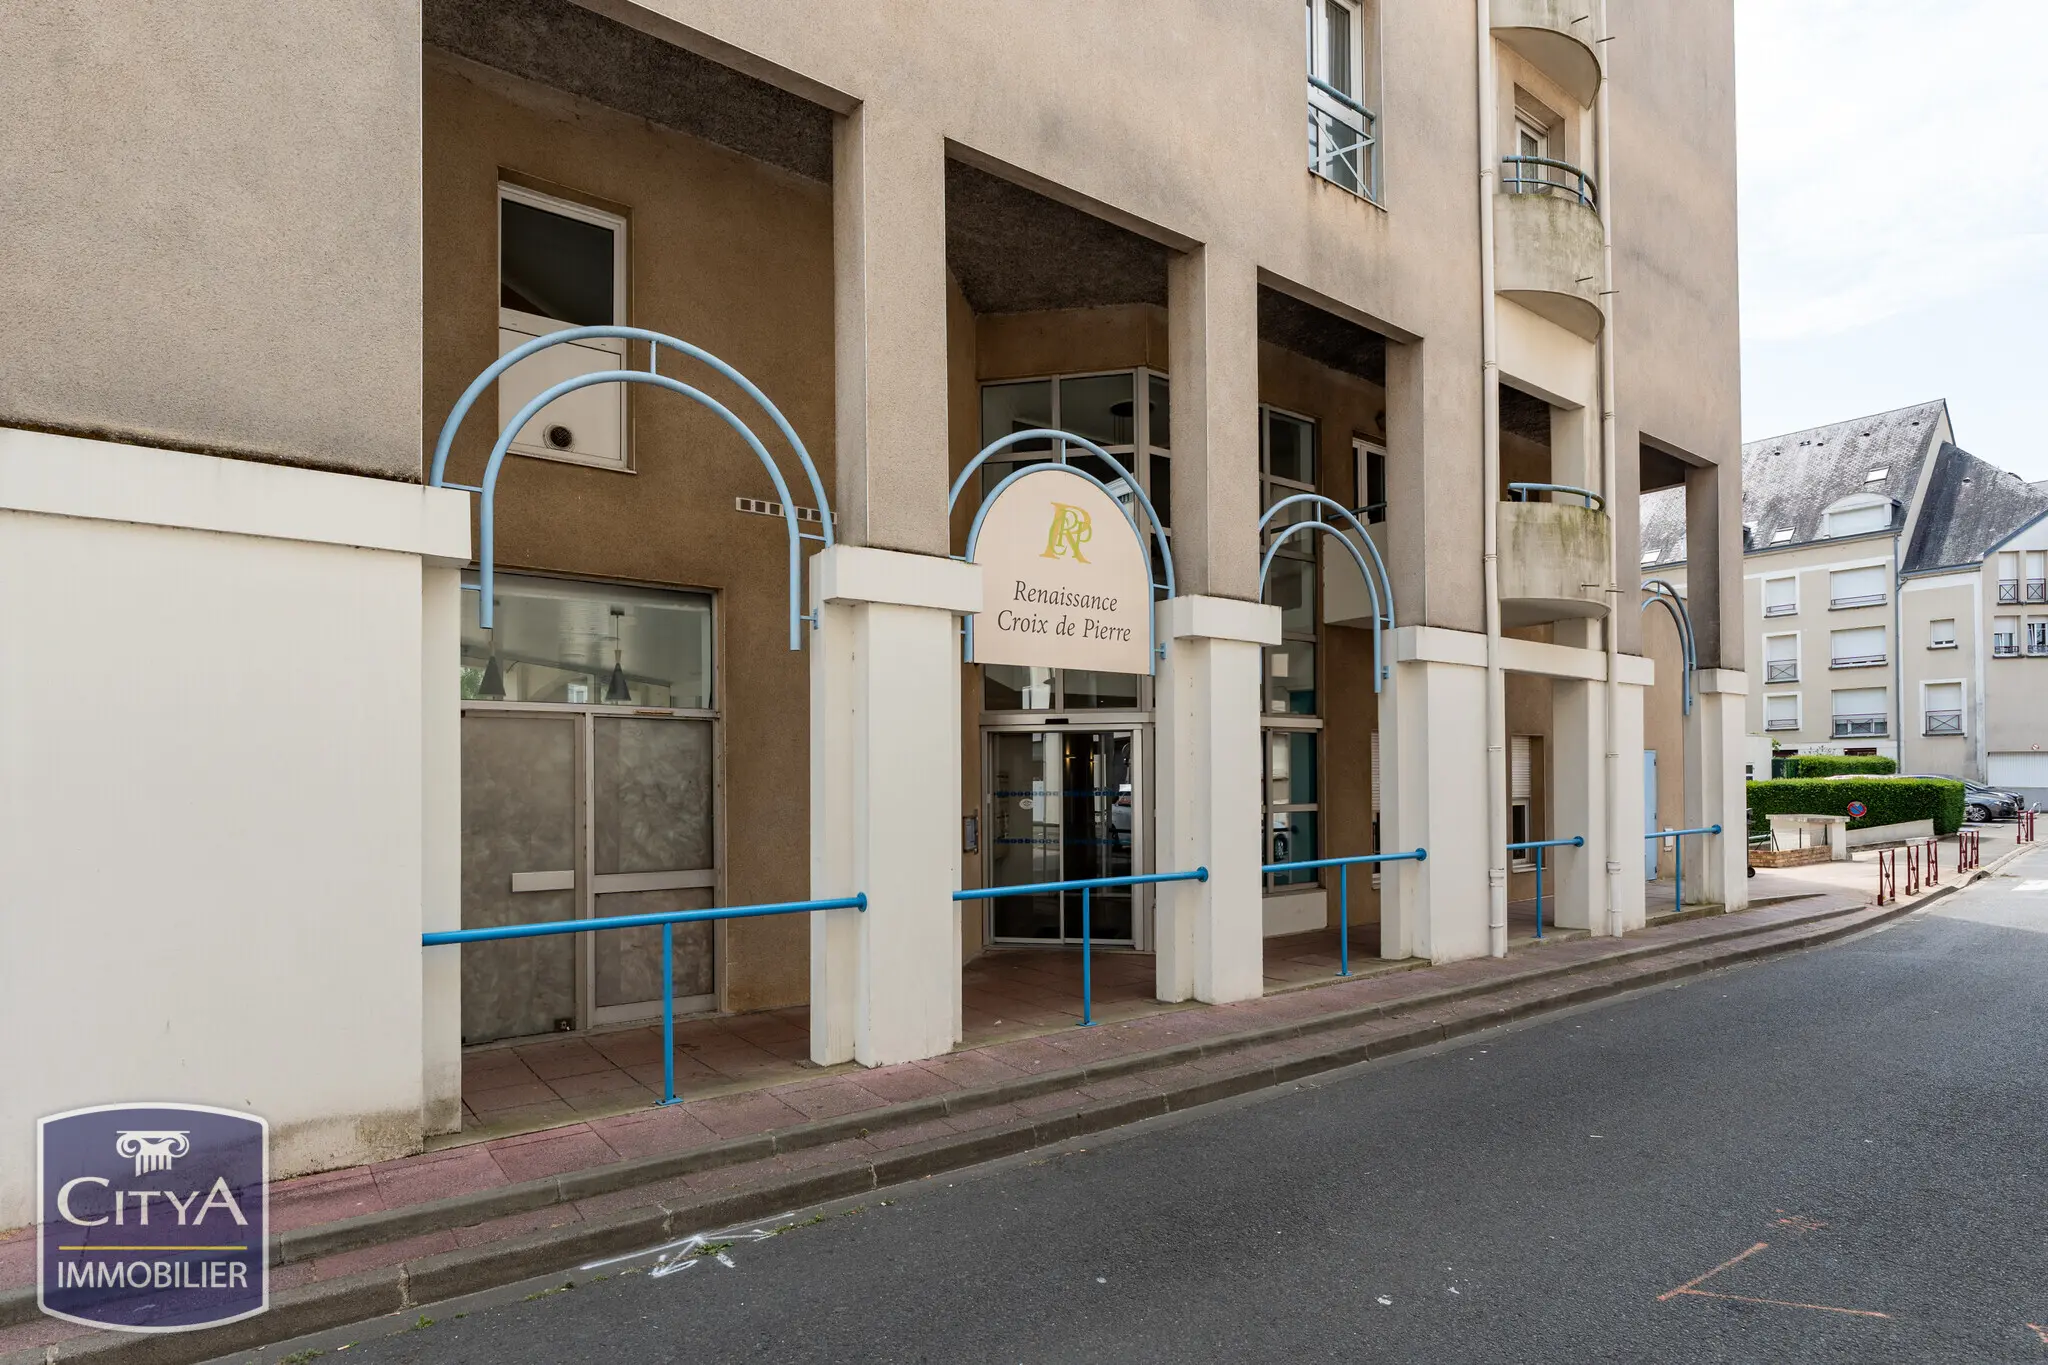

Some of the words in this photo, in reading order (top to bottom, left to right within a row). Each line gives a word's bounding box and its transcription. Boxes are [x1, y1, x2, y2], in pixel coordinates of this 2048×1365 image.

[1013, 580, 1118, 612] Renaissance
[997, 609, 1048, 634] Croix
[1055, 614, 1075, 636] de
[1082, 618, 1131, 642] Pierre
